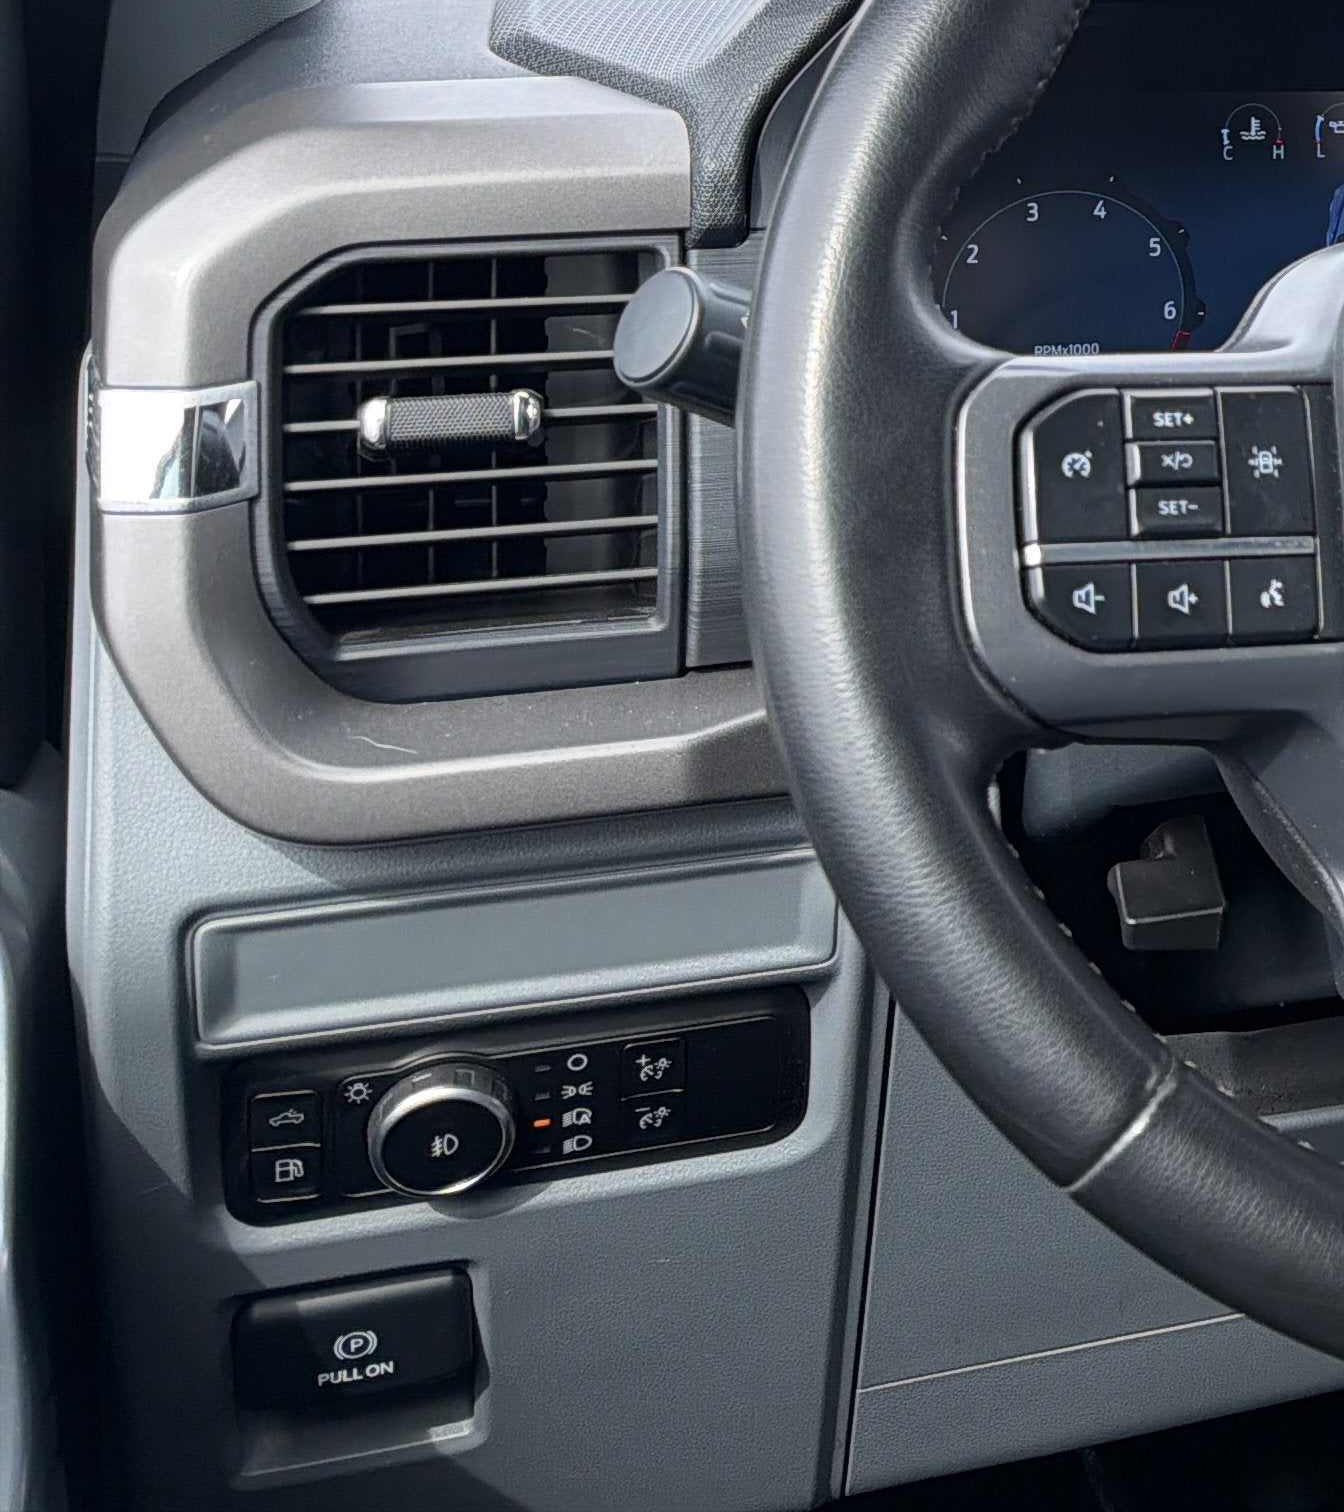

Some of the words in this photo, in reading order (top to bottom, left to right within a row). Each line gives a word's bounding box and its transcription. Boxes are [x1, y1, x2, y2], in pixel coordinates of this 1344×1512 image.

[1223, 146, 1233, 161] C
[1272, 145, 1285, 160] H
[1316, 143, 1326, 158] L
[1026, 202, 1039, 222] 3
[1093, 199, 1107, 219] 4
[966, 244, 979, 264] 2
[1149, 237, 1161, 257] 5
[1163, 301, 1177, 320] 6
[318, 1368, 364, 1387] PULL
[366, 1361, 394, 1377] ON
